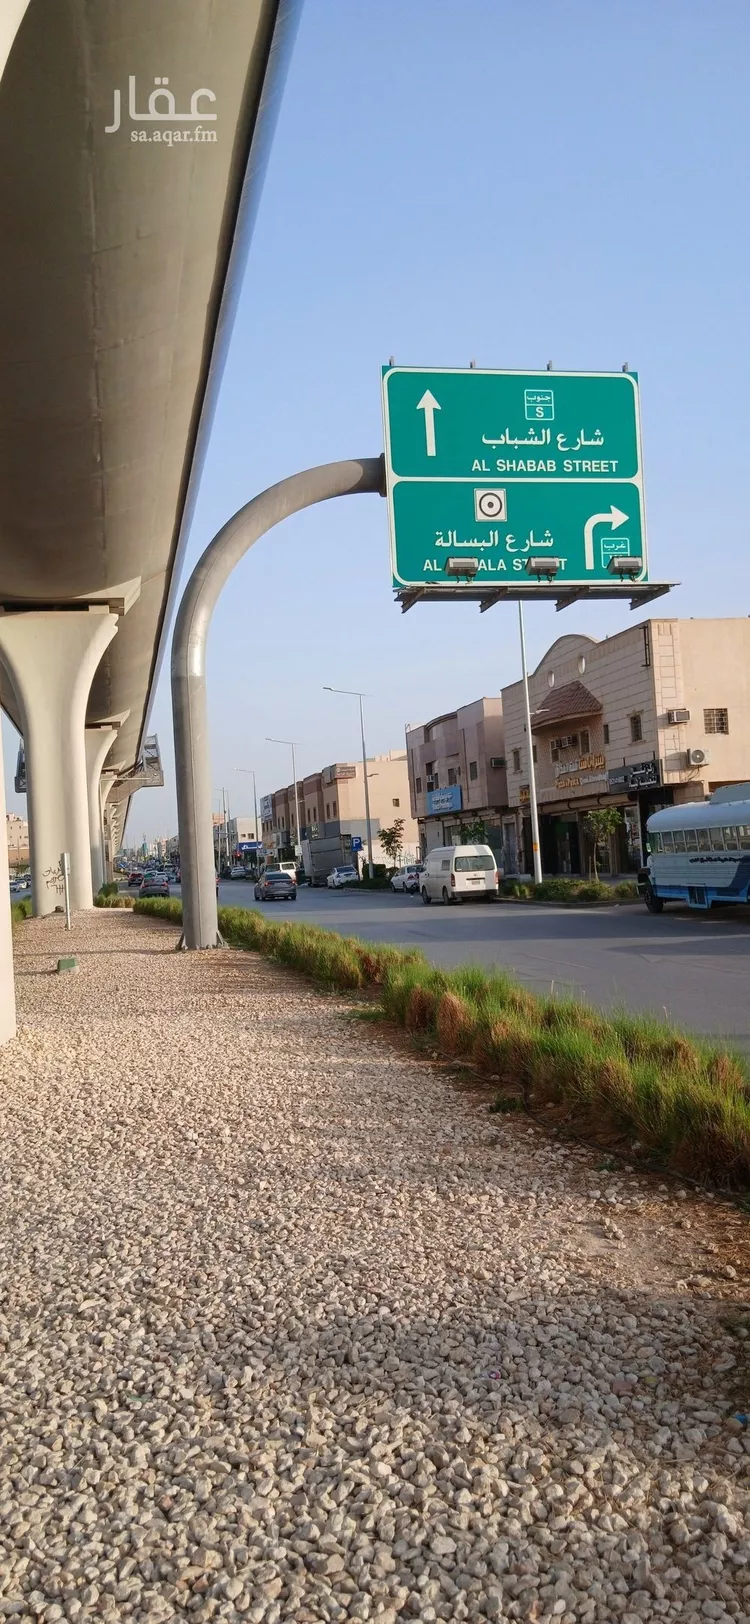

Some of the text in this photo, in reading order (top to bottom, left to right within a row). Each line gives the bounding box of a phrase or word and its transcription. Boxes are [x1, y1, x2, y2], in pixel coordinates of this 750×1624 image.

[526, 393, 551, 403] جنوب
[535, 406, 544, 418] S
[481, 428, 605, 452] شارع الشباب
[471, 460, 619, 473] AL SHABAB STREET
[434, 530, 554, 552] شارع البسالة
[603, 541, 627, 551] غرب
[423, 559, 443, 571] AL
[352, 838, 361, 848] P
